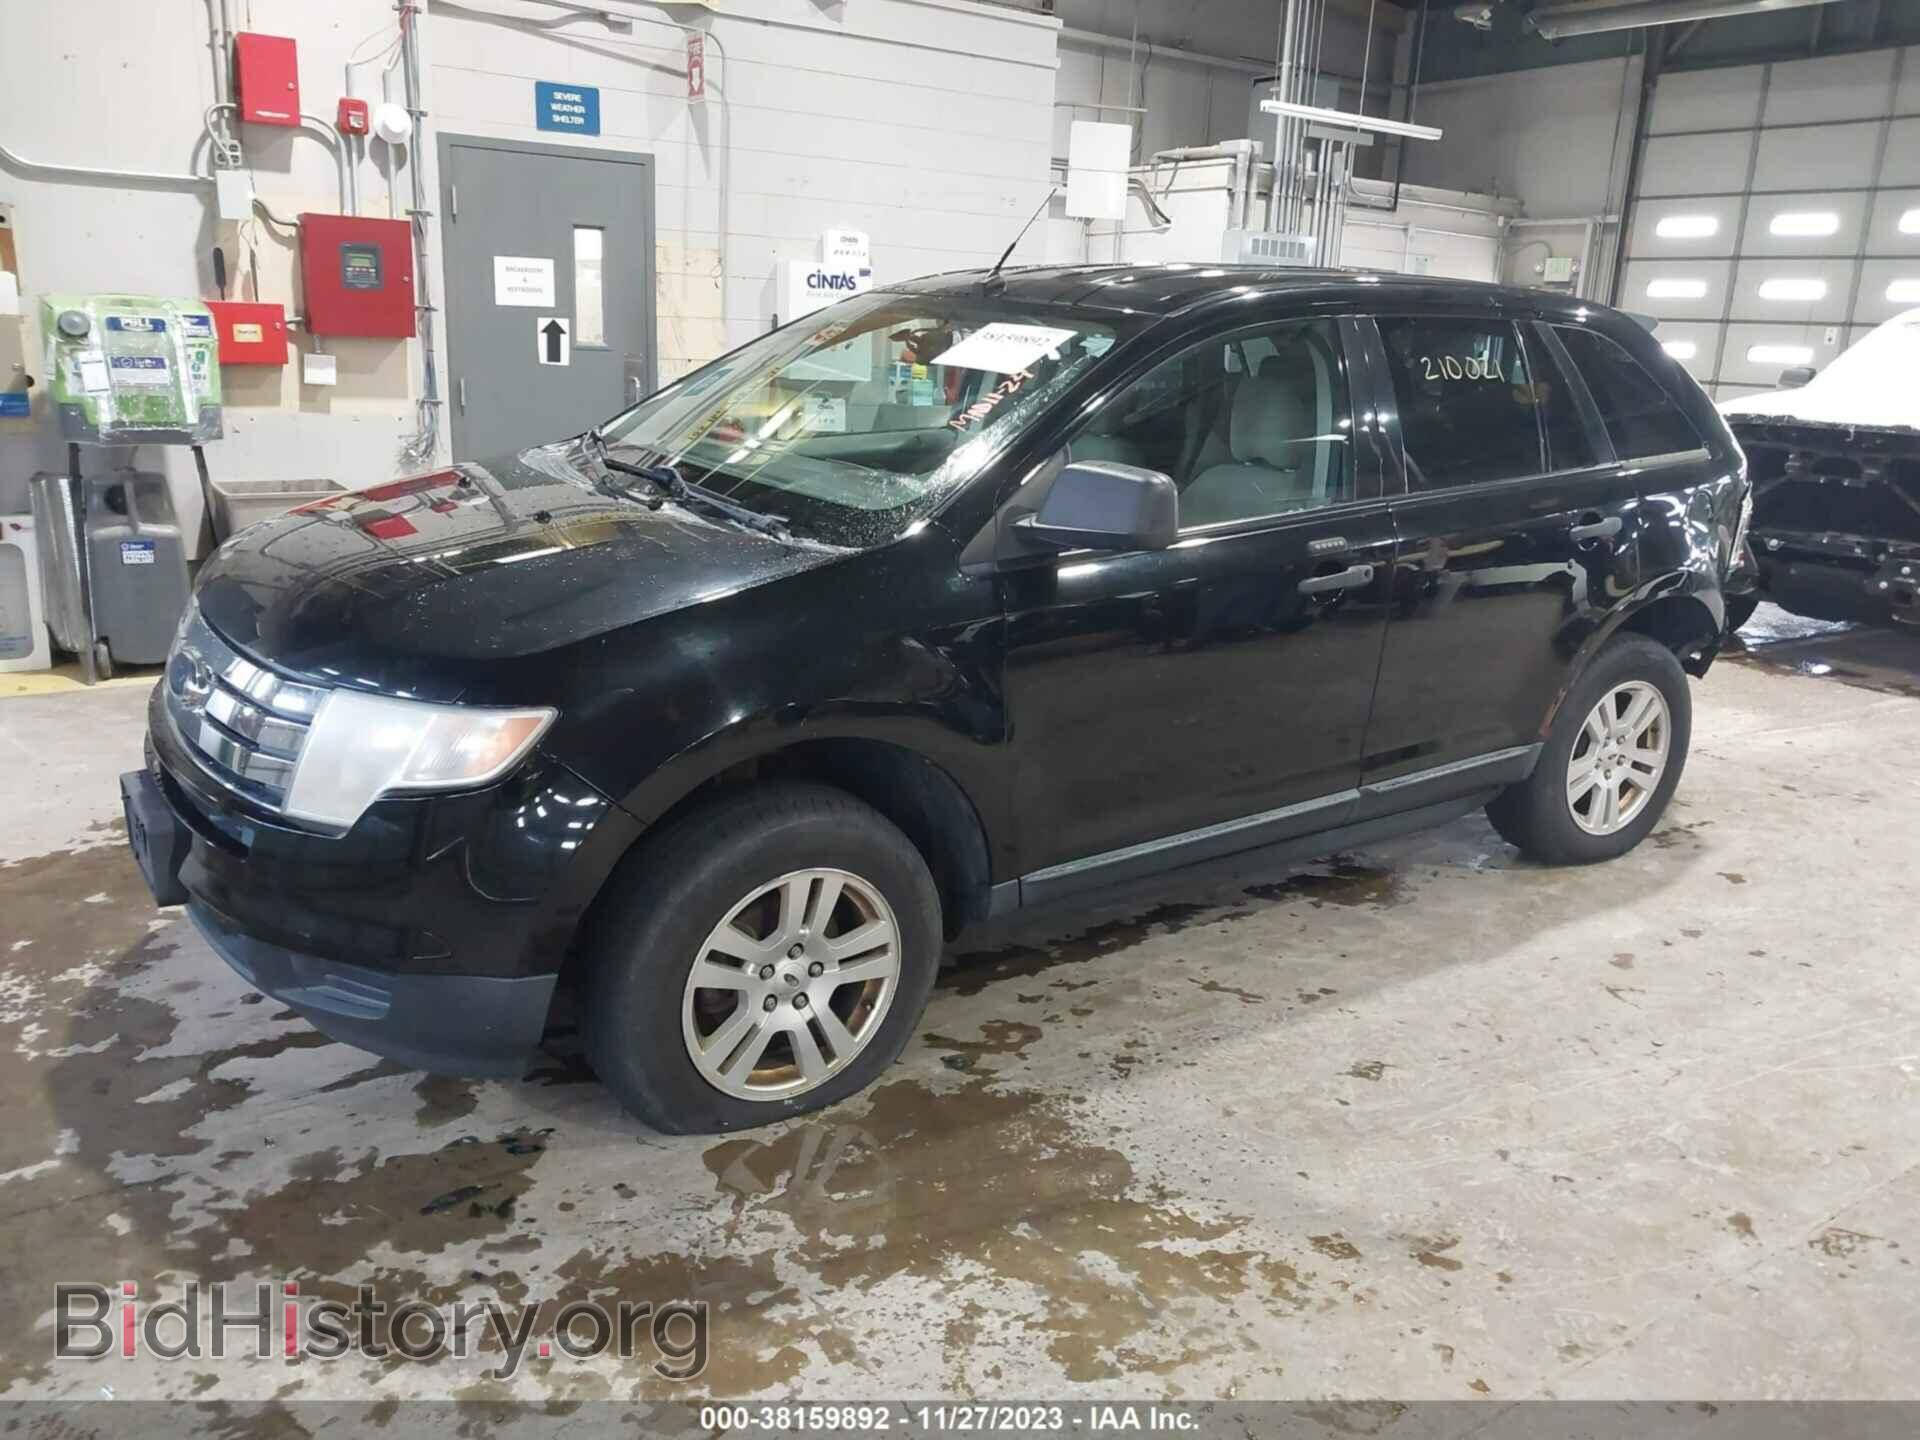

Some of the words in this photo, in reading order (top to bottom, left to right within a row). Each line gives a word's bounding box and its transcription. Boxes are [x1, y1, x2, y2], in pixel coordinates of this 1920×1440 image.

[552, 91, 583, 102] SEVERE
[551, 103, 586, 113] WEATHER
[552, 114, 585, 125] SHELTER
[1420, 355, 1505, 384] 210021
